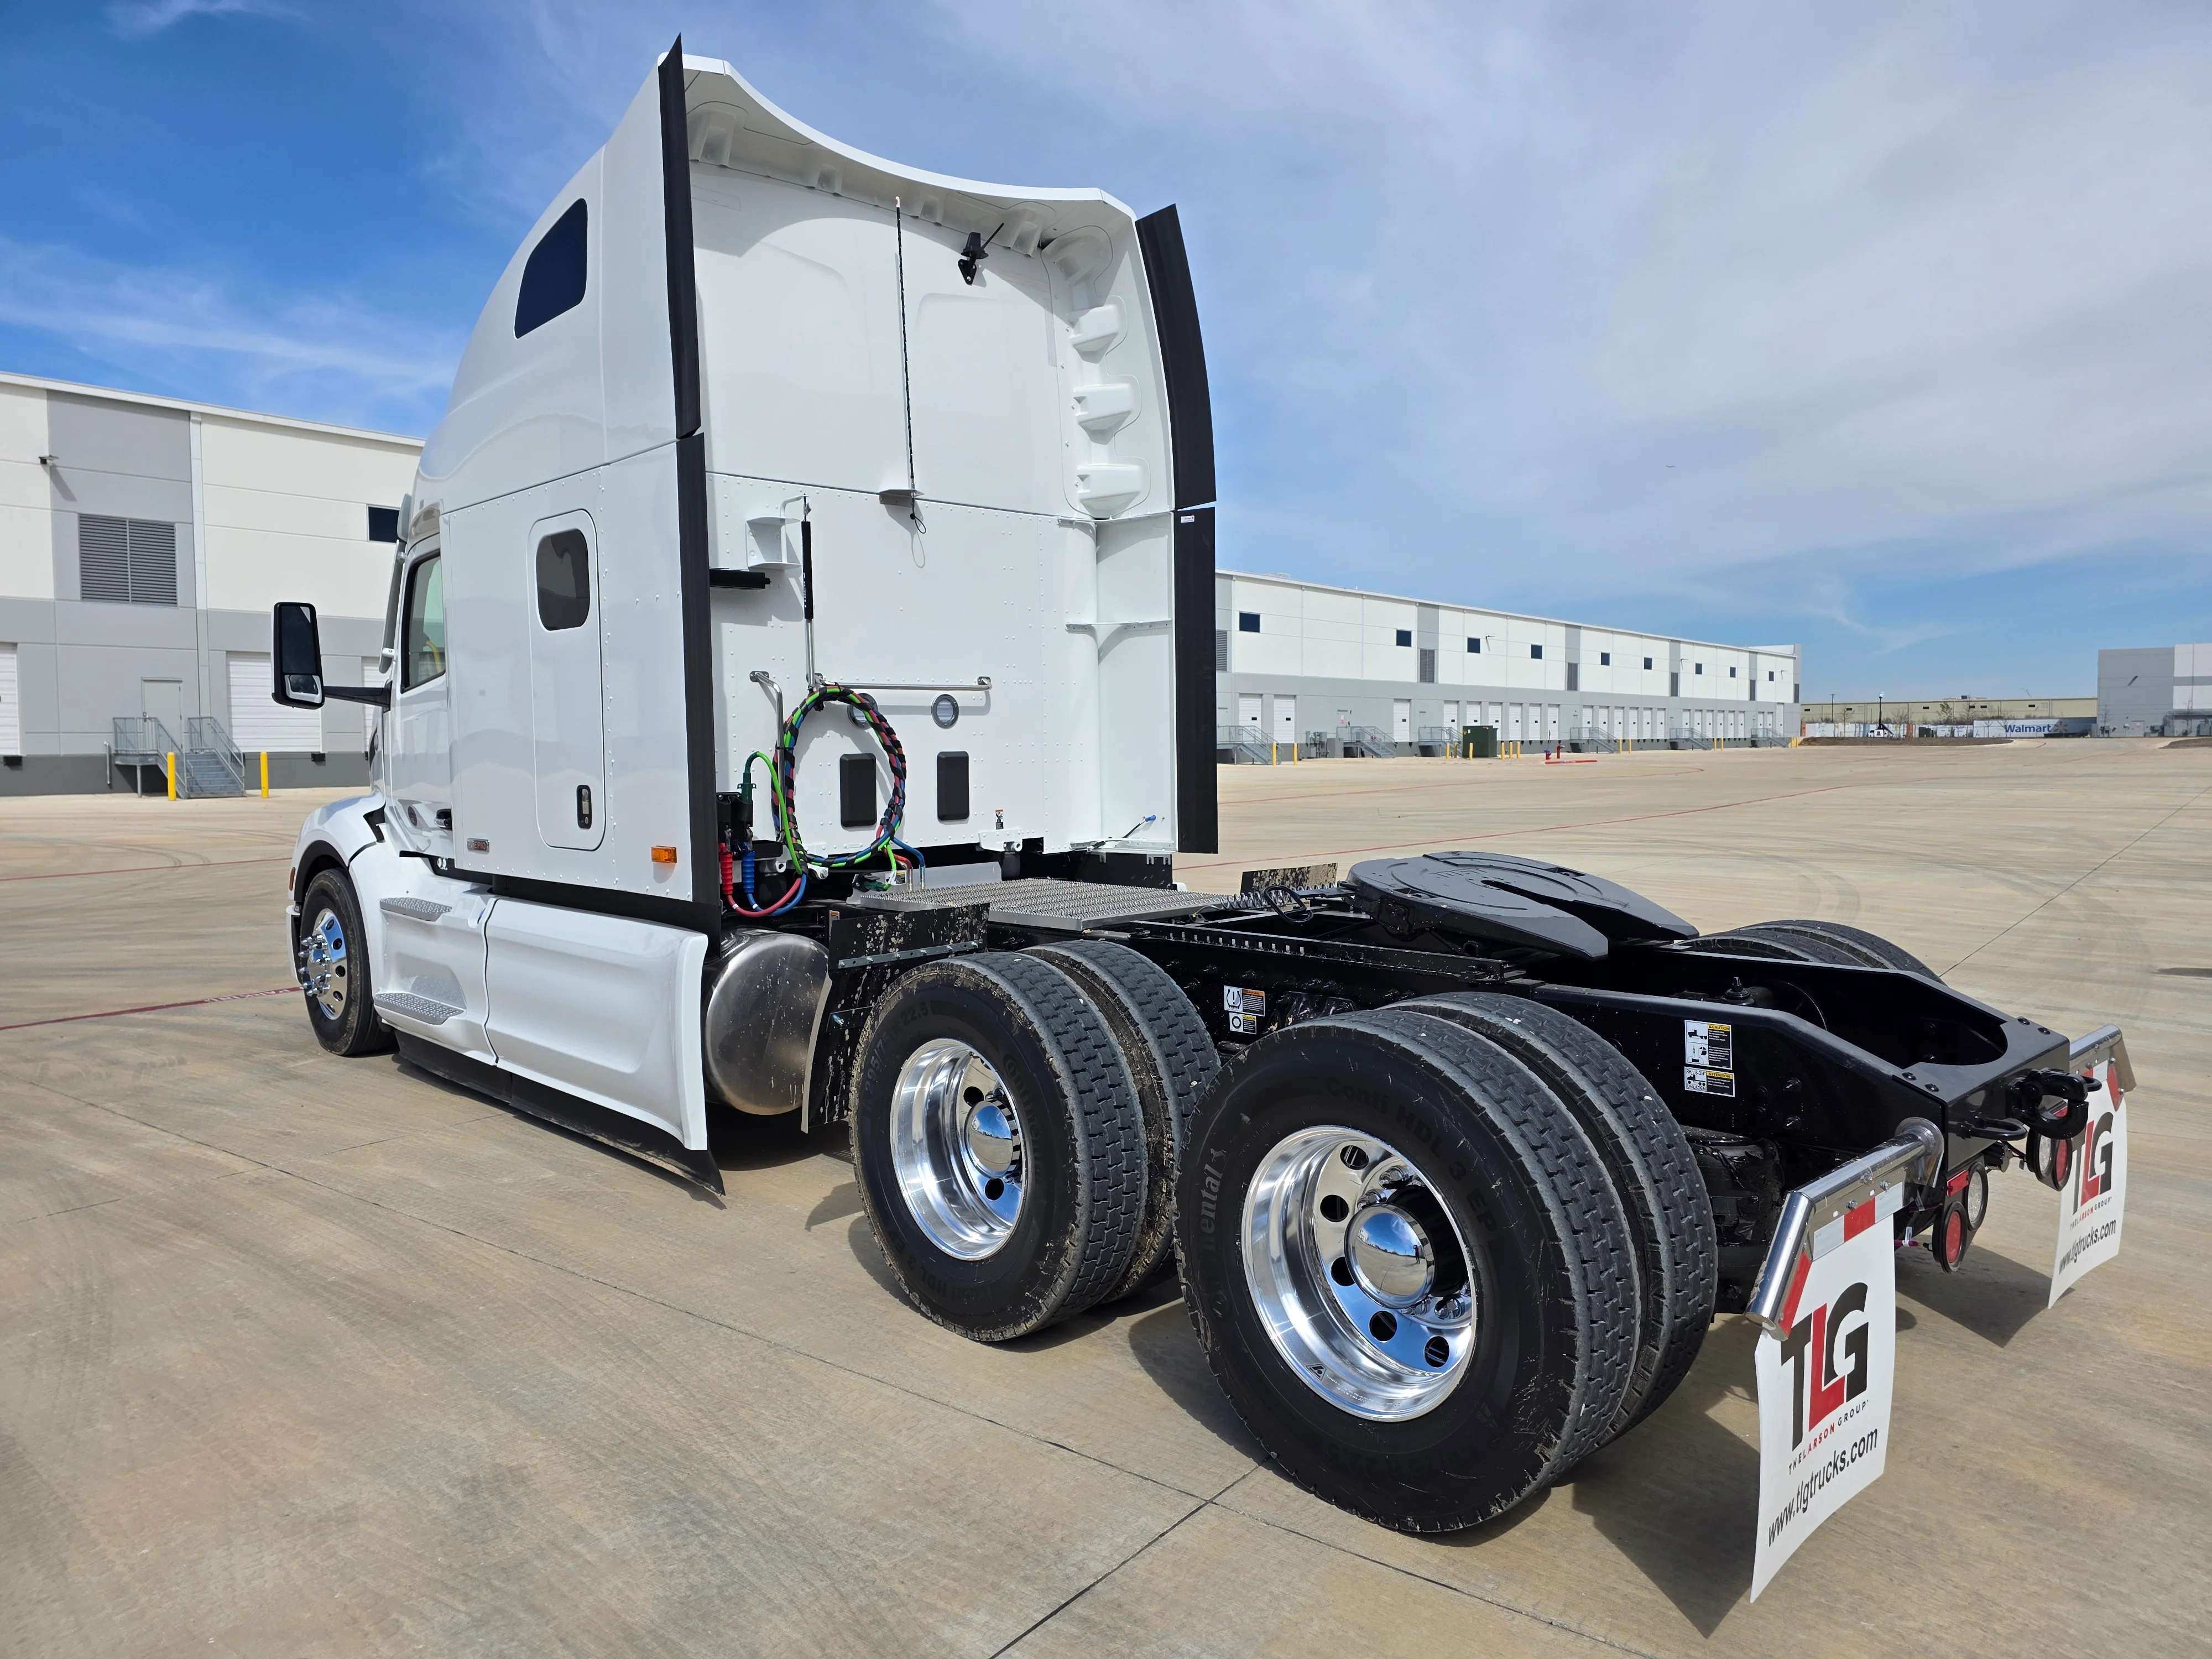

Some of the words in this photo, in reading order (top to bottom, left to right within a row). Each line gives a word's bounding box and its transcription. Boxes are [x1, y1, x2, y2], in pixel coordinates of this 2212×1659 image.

[2004, 724, 2051, 733] Walmart
[474, 841, 486, 850] EPIQ
[1326, 1076, 1390, 1114] Conti
[1395, 1104, 1442, 1160] HDL
[1449, 1160, 1467, 1182] 3
[1465, 1187, 1497, 1231] EP
[2072, 1112, 2114, 1215] TLG
[2059, 1219, 2116, 1275] www.tlgtrucks.com
[1781, 1282, 1869, 1452] TLG
[1838, 1402, 1867, 1427] GROUP
[1768, 1428, 1878, 1548] www.tlgtrucks.com
